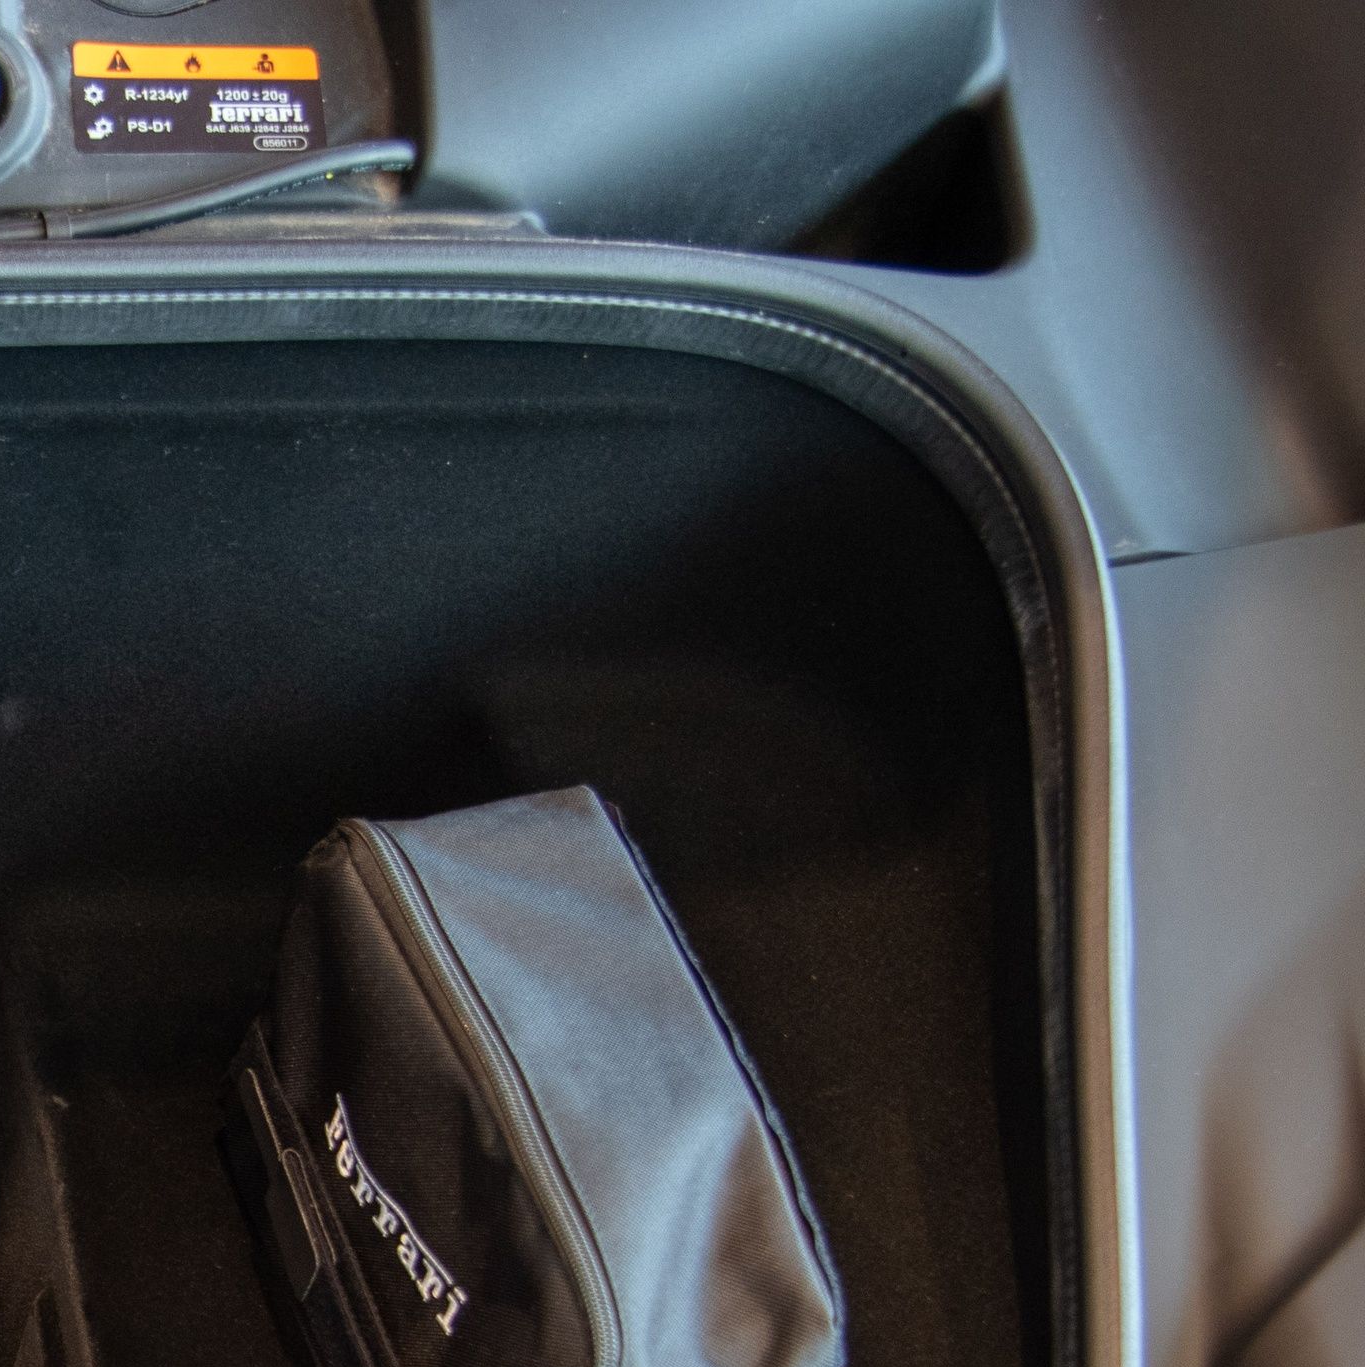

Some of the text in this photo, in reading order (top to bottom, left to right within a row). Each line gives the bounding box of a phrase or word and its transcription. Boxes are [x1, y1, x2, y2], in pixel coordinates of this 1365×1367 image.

[125, 88, 189, 103] R-1234yf
[217, 90, 250, 101] 1200
[262, 90, 289, 104] 20g
[208, 103, 302, 122] Ferrari
[128, 121, 171, 133] PS-D1
[206, 125, 227, 133] SAE
[324, 1092, 471, 1337] Ferrari
